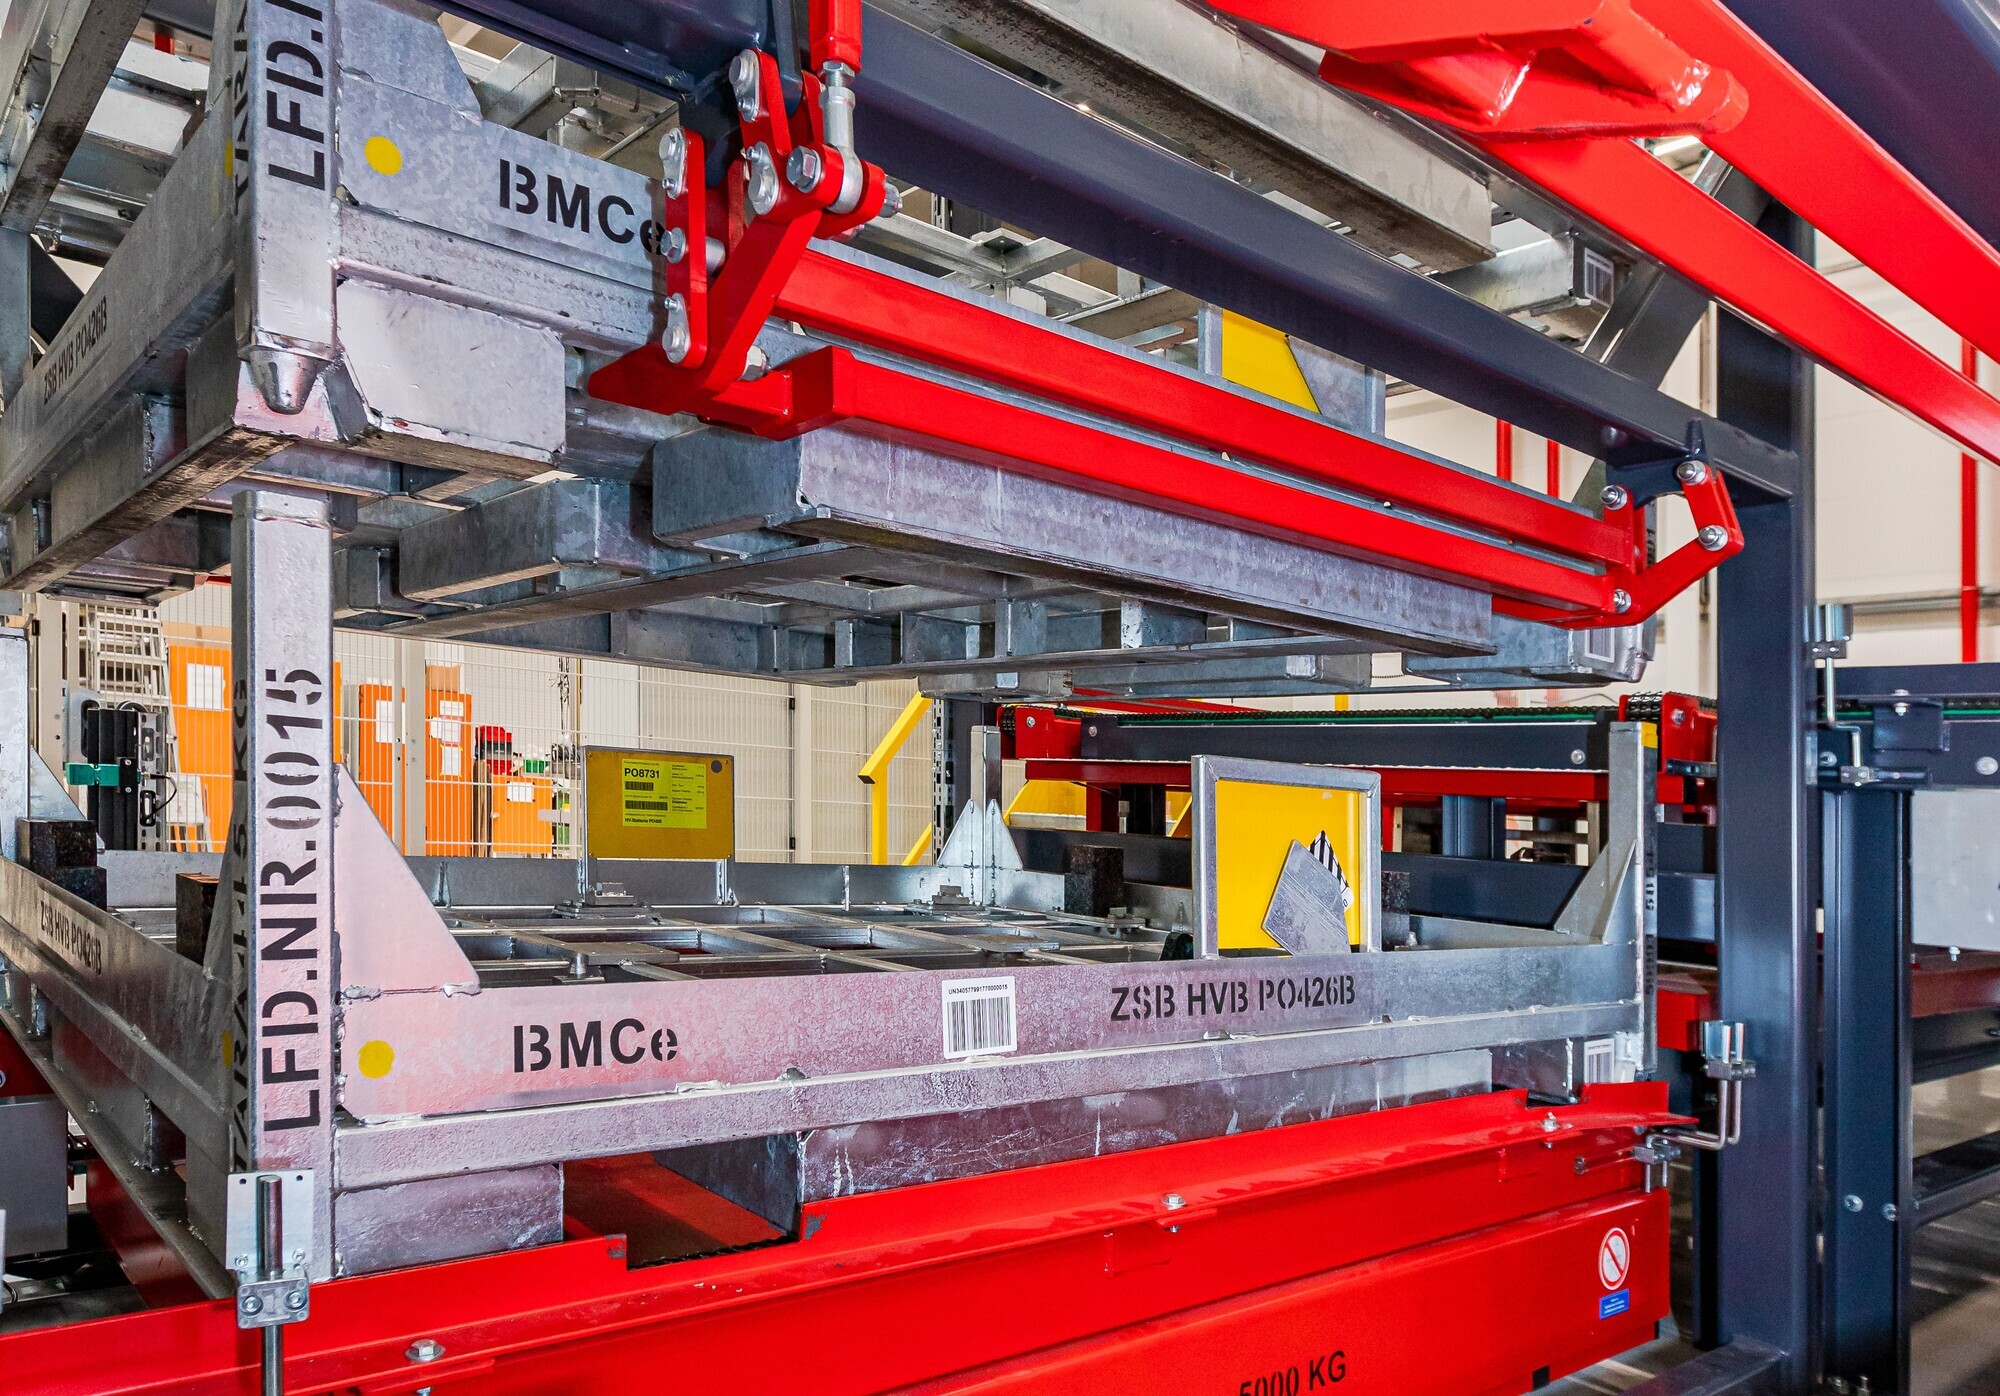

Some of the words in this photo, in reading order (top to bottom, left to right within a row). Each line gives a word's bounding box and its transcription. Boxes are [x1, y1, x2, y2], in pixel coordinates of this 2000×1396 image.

[499, 157, 667, 256] BMCe
[233, 679, 248, 783] KG
[624, 767, 660, 779] PO8731
[1110, 983, 1176, 1022] ZSB
[1187, 980, 1249, 1017] HVB
[1258, 974, 1356, 1012] PO426B
[513, 1017, 678, 1074] BMCe
[1308, 1350, 1346, 1391] KG
